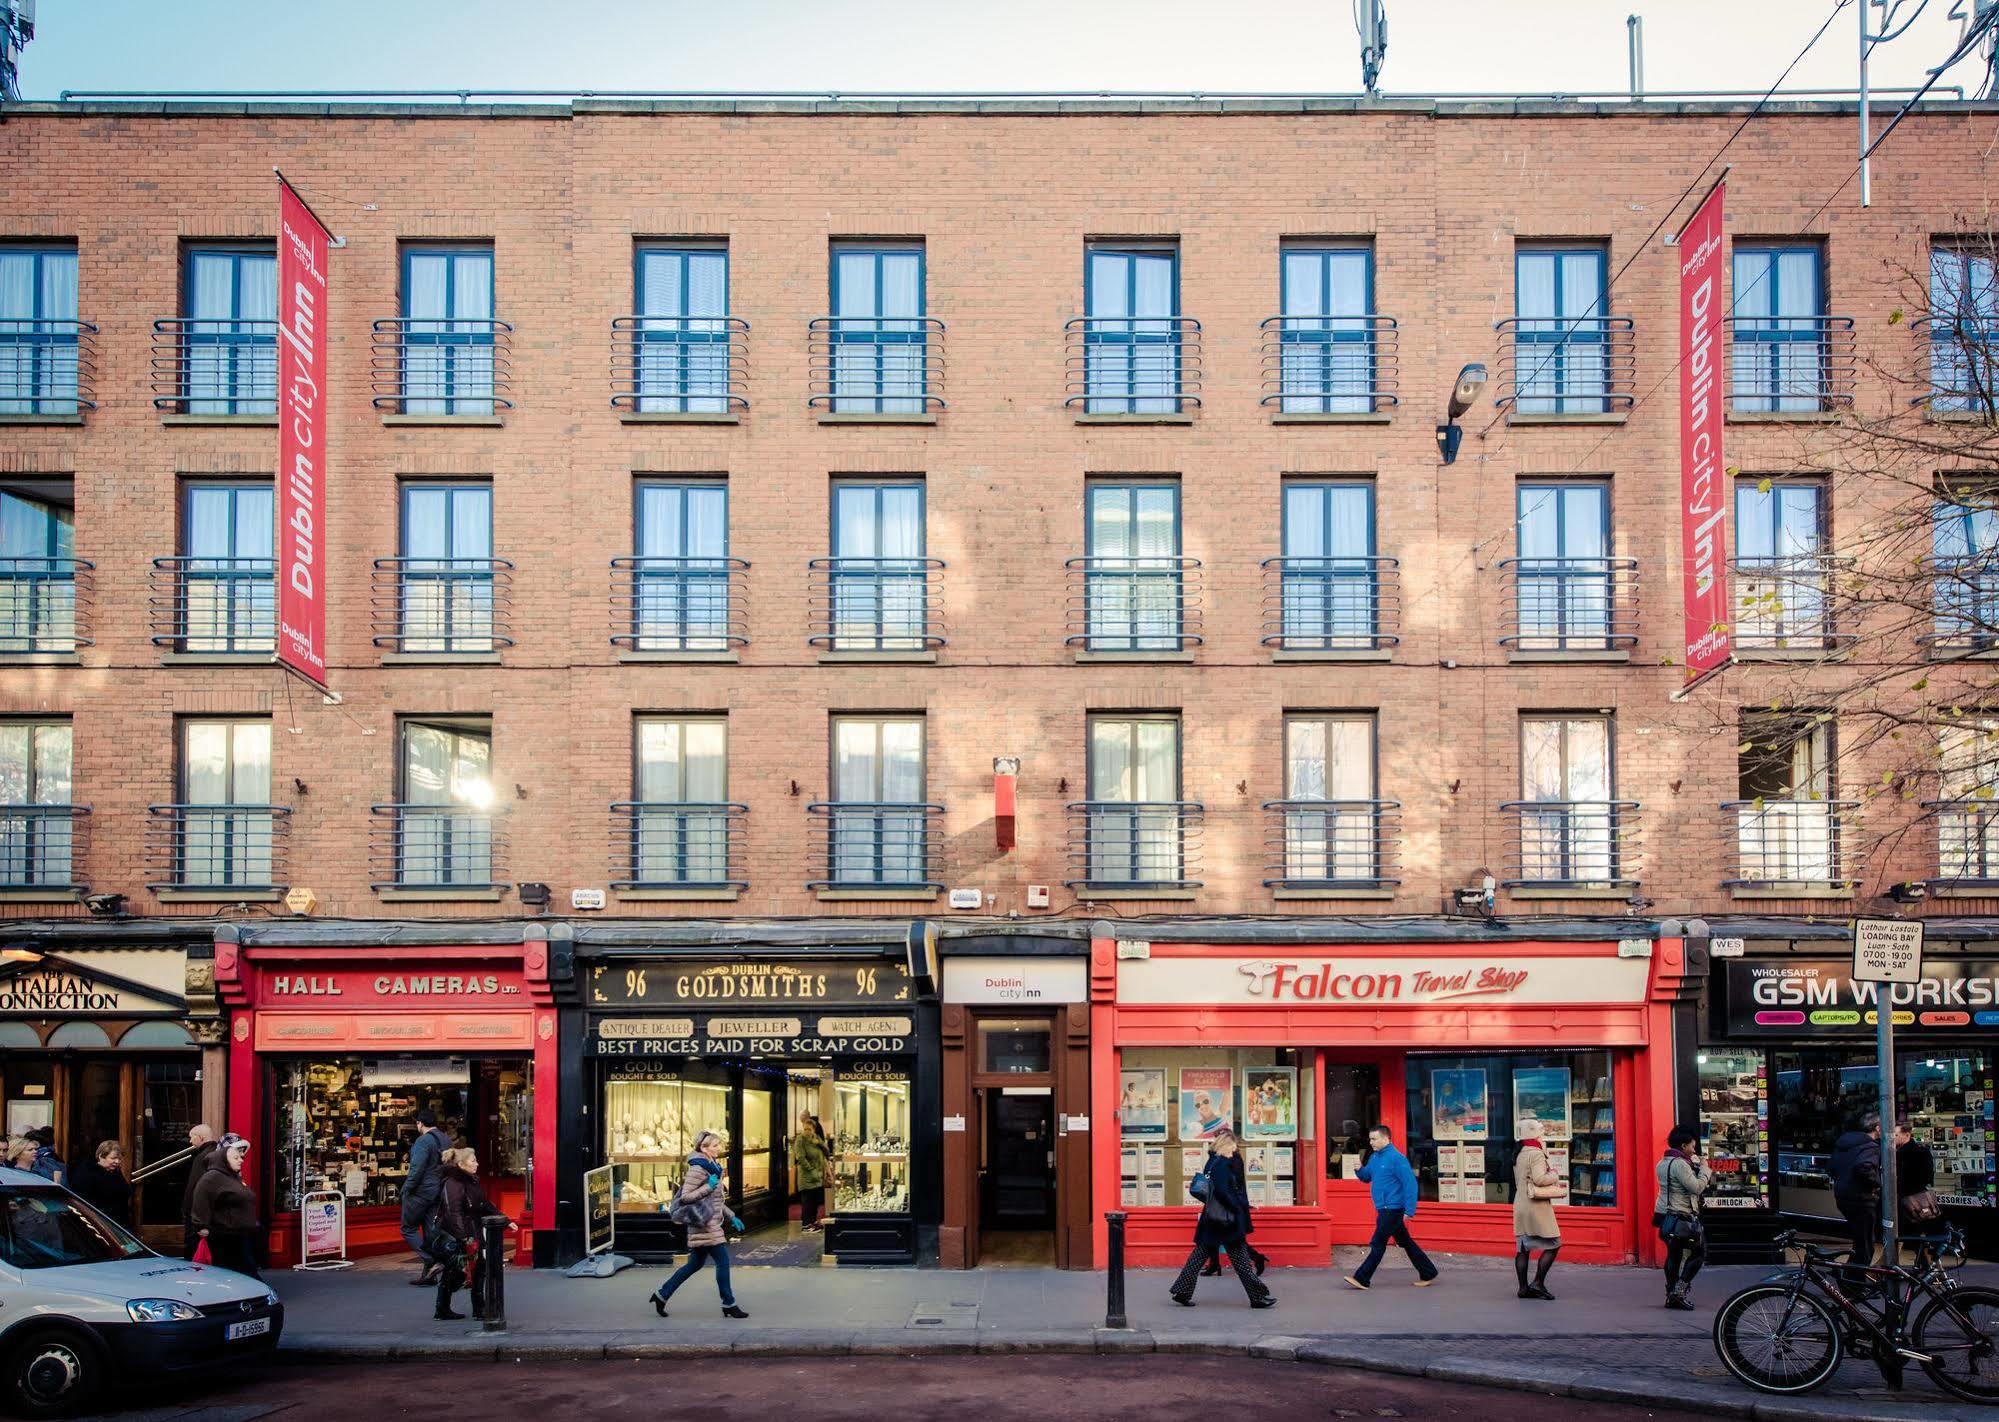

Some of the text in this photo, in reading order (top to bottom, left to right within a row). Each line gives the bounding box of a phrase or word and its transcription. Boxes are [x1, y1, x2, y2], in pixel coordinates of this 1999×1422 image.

[283, 220, 312, 260] Dublin
[1682, 240, 1708, 277] Dublin
[279, 281, 318, 600] Dublin city Inn
[1690, 275, 1726, 599] Dublin city Inn
[281, 620, 311, 647] Dublin
[1687, 631, 1713, 657] Dublin
[1716, 940, 1741, 948] WES
[1862, 932, 1915, 942] LOADING BAY
[1868, 942, 1886, 950] Luan
[732, 964, 771, 976] DUBLIN
[1867, 960, 1887, 968] MON
[1892, 961, 1907, 969] SAT
[1751, 968, 1820, 977] WHOLESALER
[11, 977, 93, 994] ITALIAN
[273, 975, 343, 995] HALL
[373, 974, 500, 995] CAMERAS
[626, 969, 647, 998] 96
[676, 974, 827, 998] GOLDSMITHS
[856, 967, 877, 996] 96
[985, 978, 1022, 987] Dublin
[1272, 962, 1528, 1000] Falcon Travel Shop
[999, 986, 1022, 1000] city
[1753, 977, 1838, 1006] GSM
[0, 993, 119, 1010] ONNECTION
[1934, 1014, 1956, 1022] SALES
[603, 1022, 690, 1035] ANTIQUE DEALER
[719, 1021, 789, 1035] JEWELLER
[831, 1020, 898, 1033] WATCH AGENT
[598, 1037, 905, 1054] BEST PRICES PAID FOR SCRAP GOLD
[624, 1061, 664, 1073] GOLD
[853, 1061, 892, 1073] GOLD
[610, 1073, 644, 1081] BOUGHT
[656, 1073, 677, 1081] SOLD
[839, 1073, 873, 1081] BOUGHT
[885, 1073, 906, 1081] SOLD
[293, 1155, 301, 1207] SERVICE
[1937, 1195, 1972, 1204] ESSORIES
